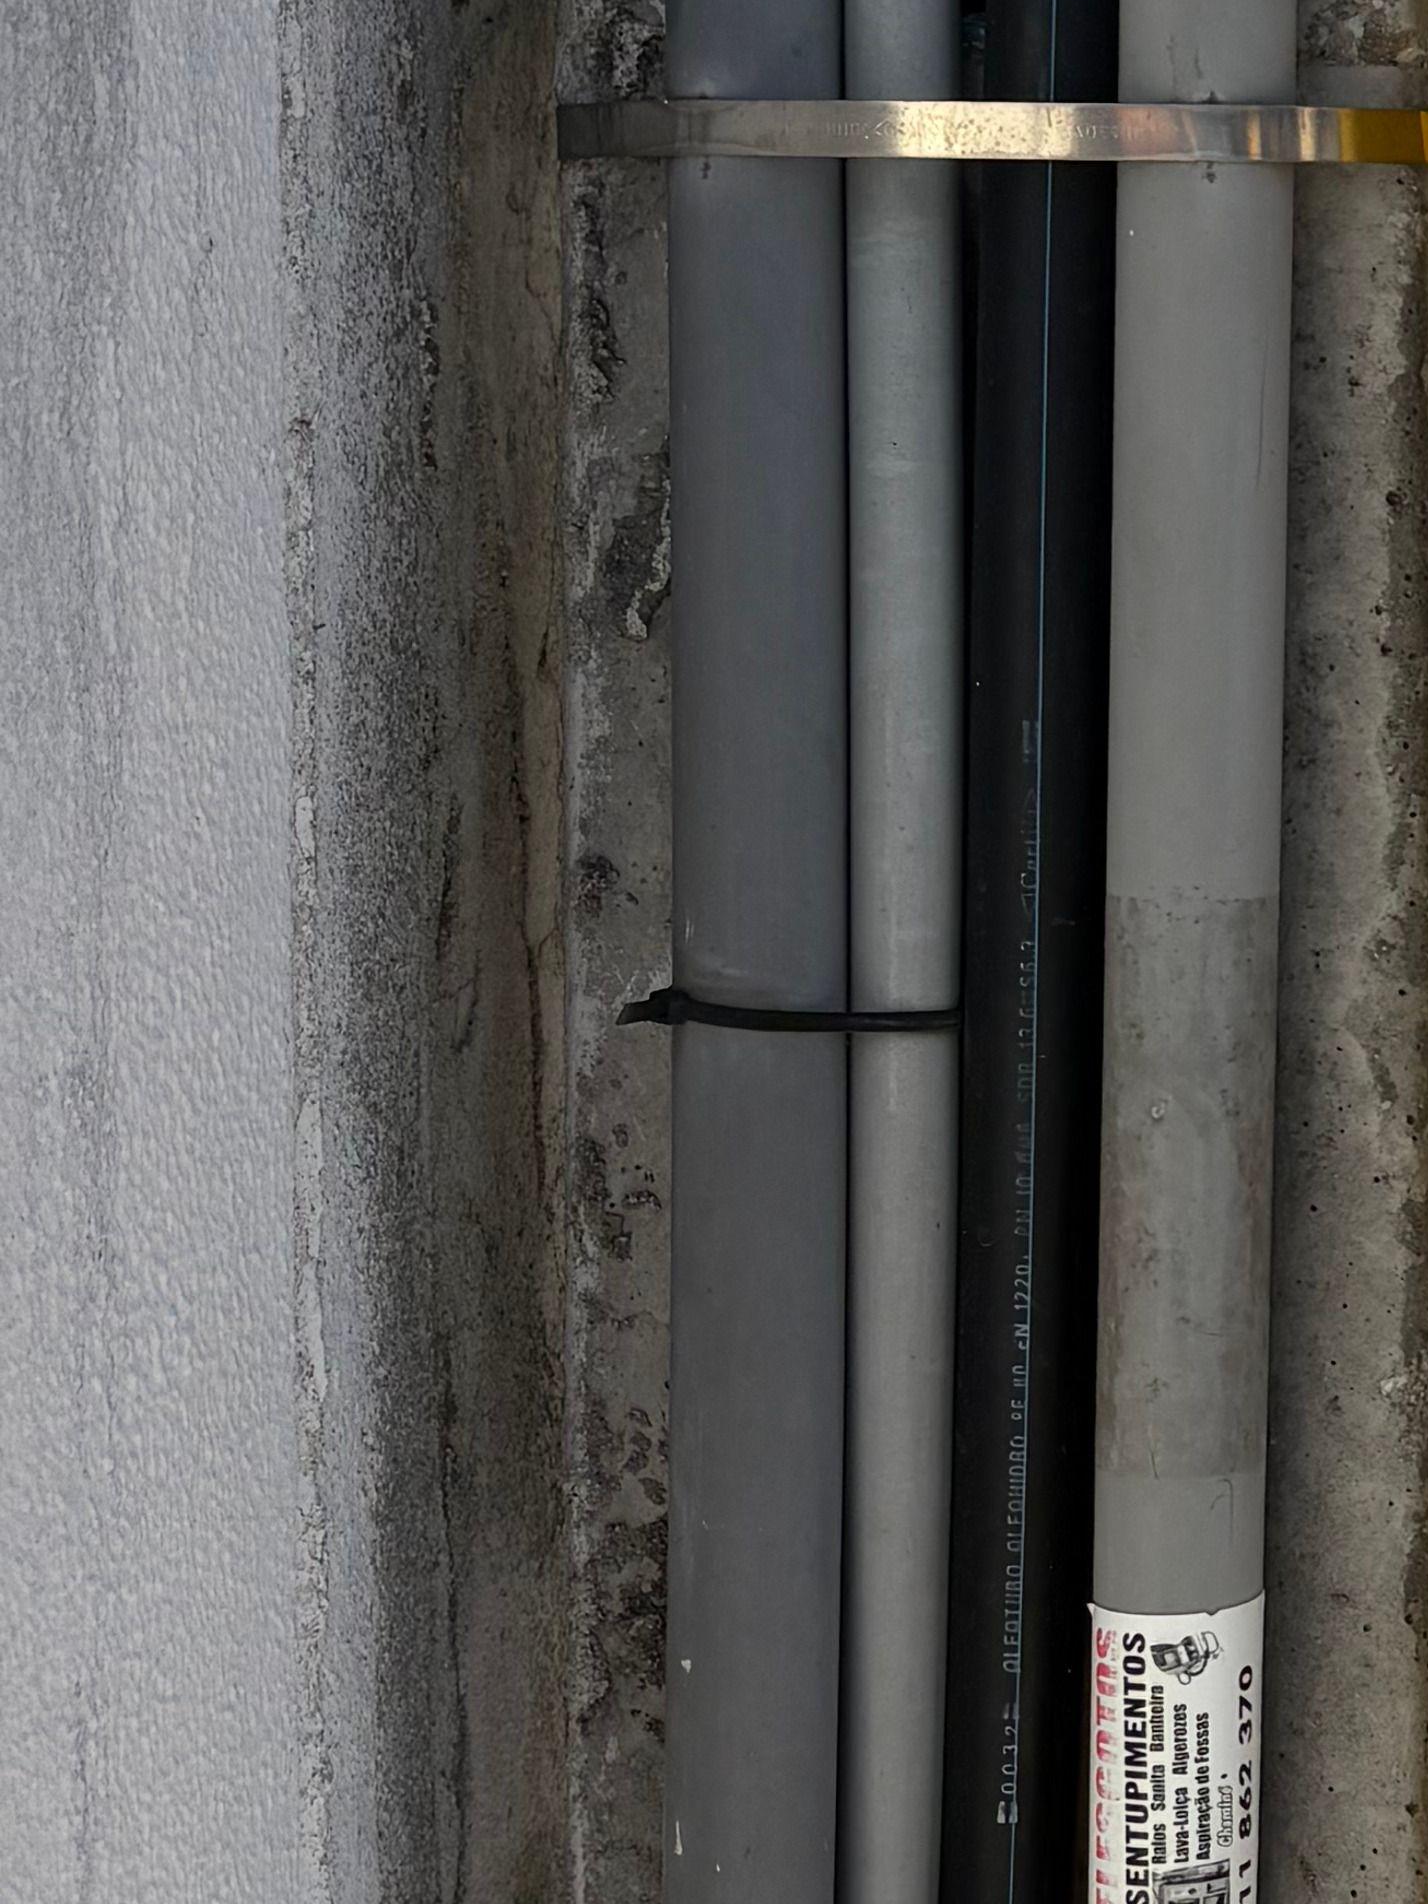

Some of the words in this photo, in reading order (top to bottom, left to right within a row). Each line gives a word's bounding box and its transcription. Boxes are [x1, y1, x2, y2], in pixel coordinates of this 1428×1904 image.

[1150, 1685, 1164, 1752] Banheira
[1172, 1703, 1187, 1775] Algerozes
[1195, 1712, 1209, 1760] Fossas
[1239, 1666, 1252, 1748] 370
[1197, 1763, 1209, 1783] de
[1239, 1760, 1252, 1839] 862
[1152, 1823, 1166, 1864] Ralos
[1174, 1787, 1189, 1863] Lava-Loiça
[1195, 1785, 1210, 1860] Aspiração
